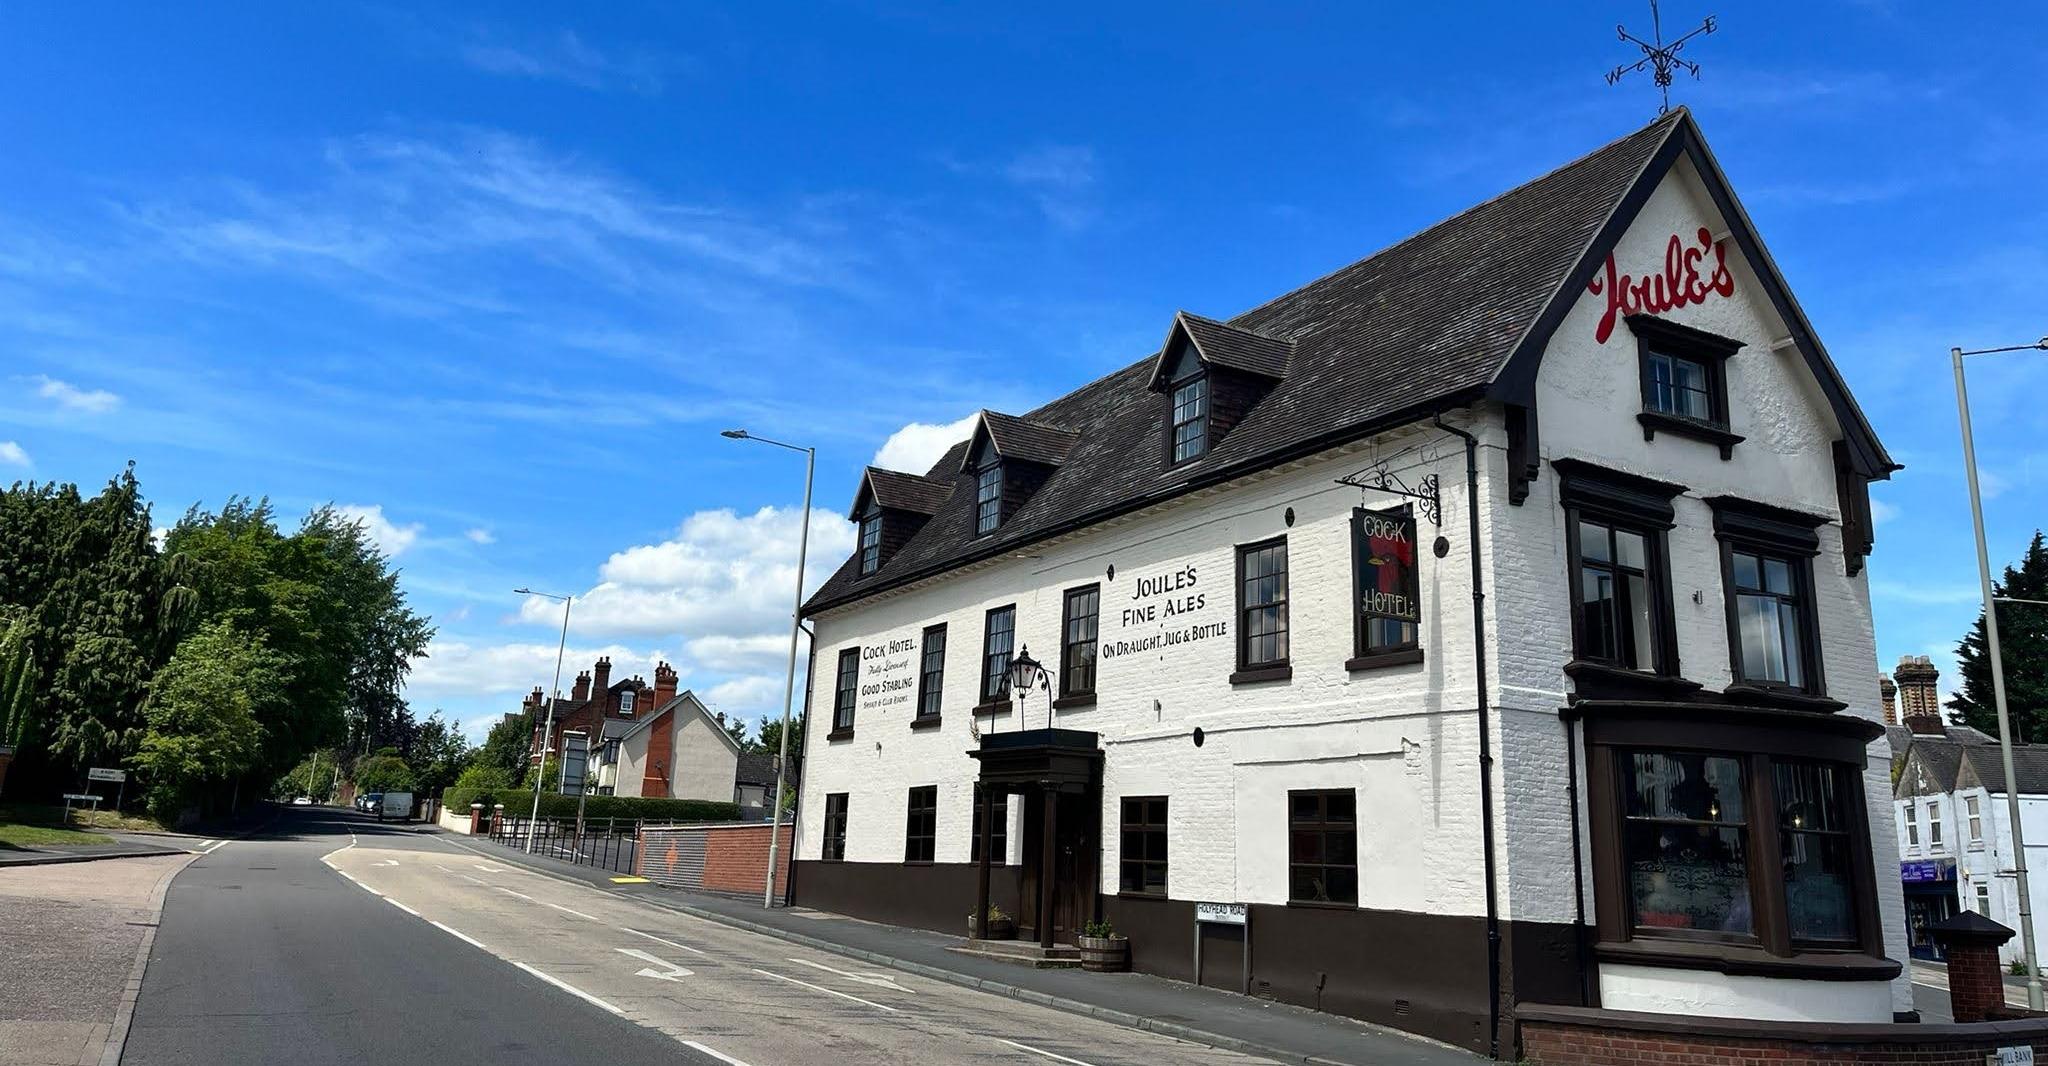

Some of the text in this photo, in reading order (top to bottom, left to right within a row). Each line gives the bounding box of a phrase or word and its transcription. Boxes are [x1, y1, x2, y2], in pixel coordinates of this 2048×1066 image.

[1363, 515, 1407, 544] COCK
[1132, 565, 1197, 600] JOULE'S
[1122, 593, 1205, 627] FINE ALES
[1363, 588, 1416, 618] HOTEL
[863, 645, 886, 660] COCK
[1102, 644, 1116, 659] ON
[1163, 631, 1182, 647] JUG
[1183, 630, 1191, 643] &
[1192, 622, 1227, 641] BOTTLE
[861, 677, 913, 696] GOOD STABLING
[1199, 904, 1227, 914] HOLYHEAD
